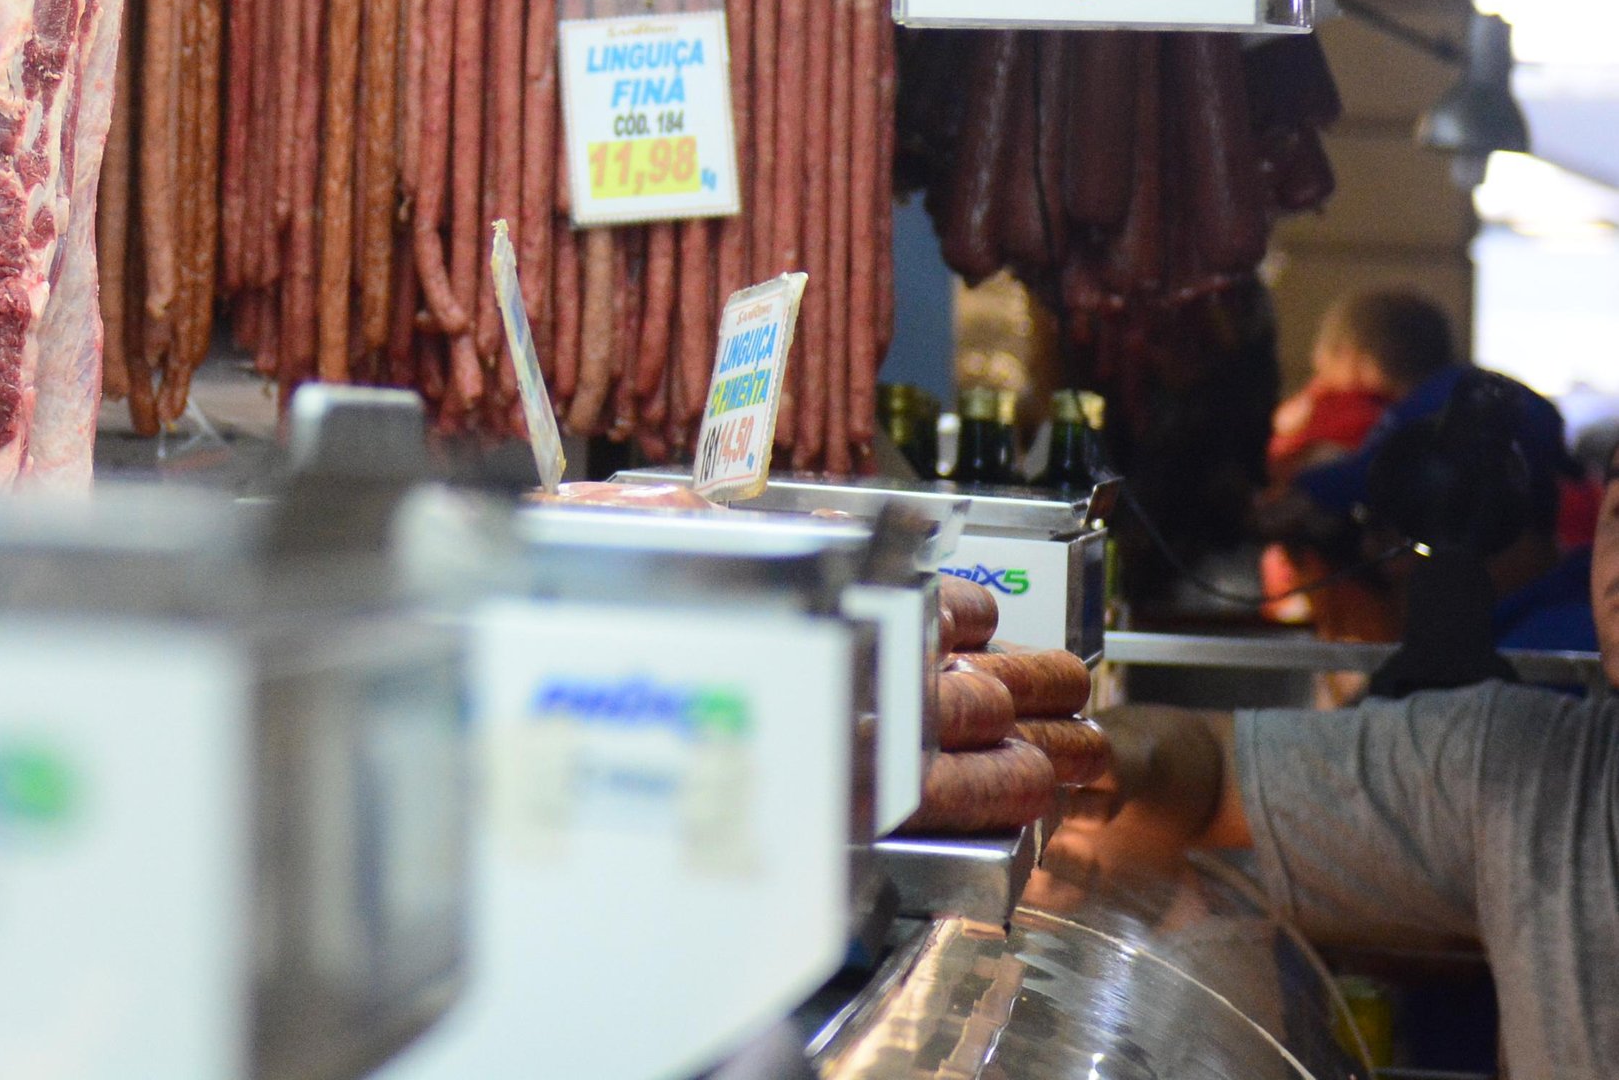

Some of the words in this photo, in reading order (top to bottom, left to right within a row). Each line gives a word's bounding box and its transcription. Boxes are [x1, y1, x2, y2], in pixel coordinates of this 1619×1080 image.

[586, 39, 704, 78] LINGUIÇA
[611, 75, 686, 108] FINA
[657, 110, 684, 134] 184
[589, 135, 697, 195] 11,98
[719, 322, 778, 375] LINGUIÇA
[700, 424, 723, 483] 181
